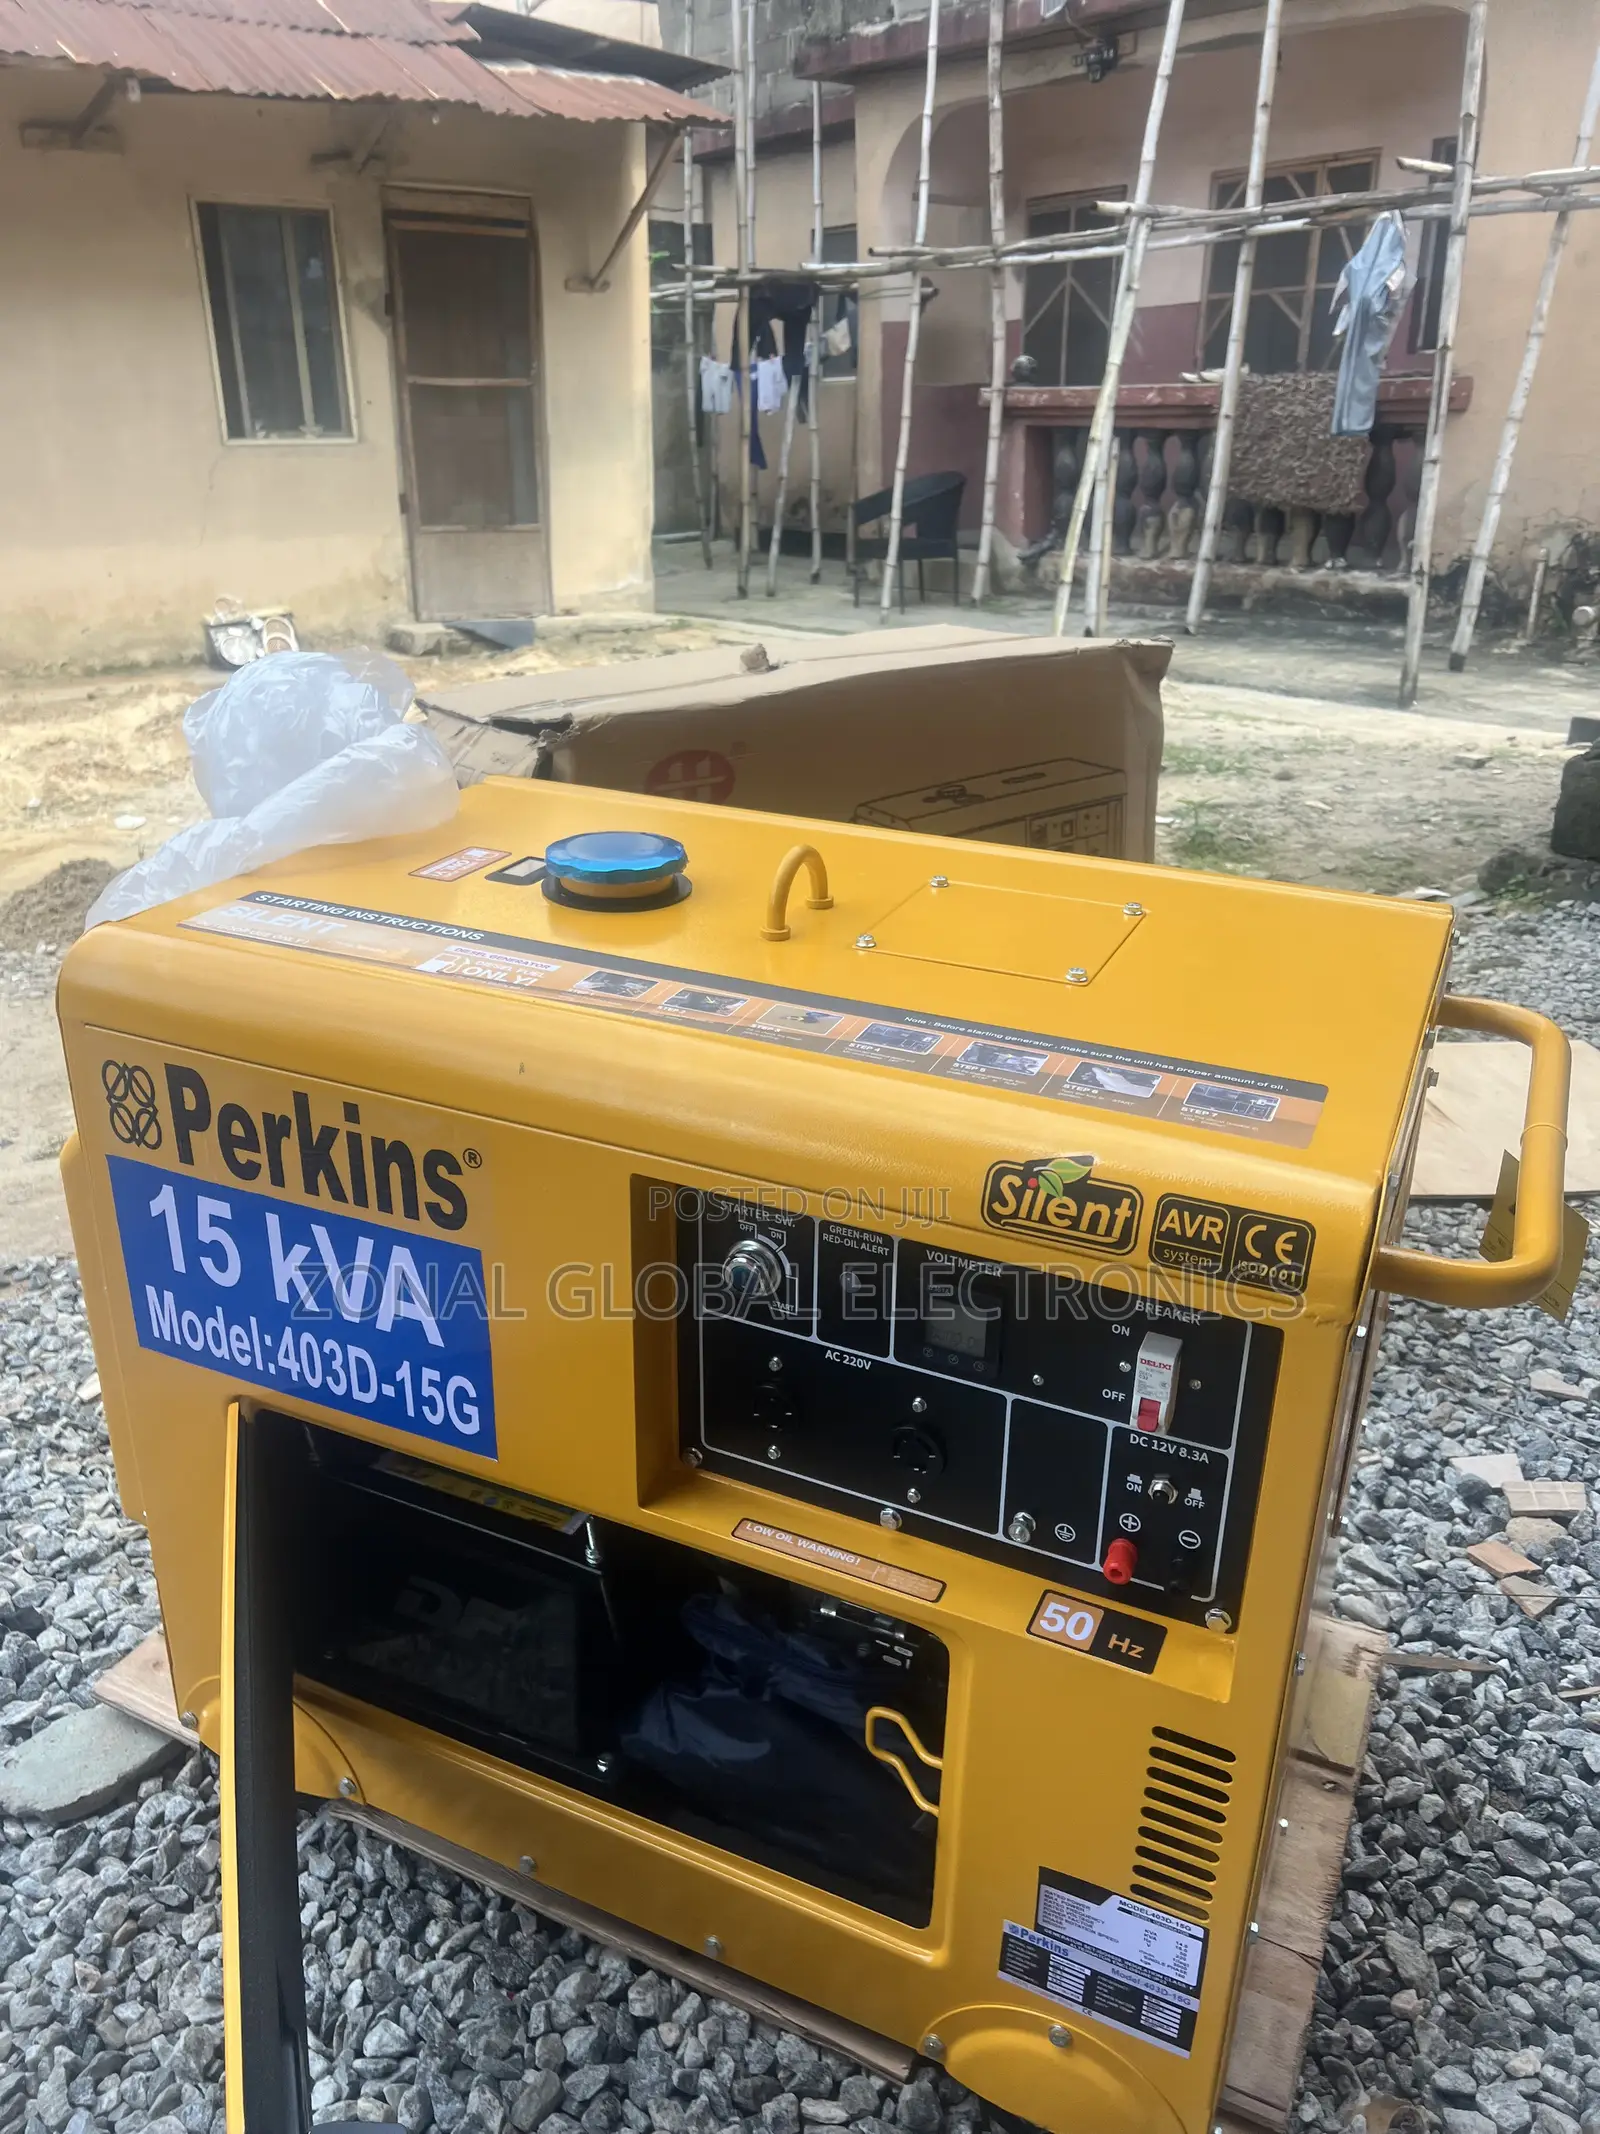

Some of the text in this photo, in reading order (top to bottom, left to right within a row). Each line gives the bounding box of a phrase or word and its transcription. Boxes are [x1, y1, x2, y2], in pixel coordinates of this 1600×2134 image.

[255, 894, 484, 941] STARTING INSTRUCTIONS
[454, 947, 551, 970] DIESEL GENERATOR
[848, 1042, 873, 1050] STEP
[904, 1016, 926, 1026] Note
[933, 1022, 965, 1033] Before
[967, 1027, 1003, 1039] starting
[1004, 1035, 1053, 1048] generator
[1060, 1044, 1087, 1055] make
[1090, 1051, 1113, 1059] sure
[1115, 1053, 1132, 1062] the
[1133, 1057, 1154, 1067] unit
[1155, 1061, 1174, 1070] has
[1176, 1066, 1212, 1078] proper
[1214, 1073, 1255, 1084] amount
[1257, 1078, 1269, 1087] of
[1270, 1082, 1284, 1091] oil
[952, 1062, 979, 1071] STEP
[1062, 1083, 1091, 1092] STEP
[1181, 1106, 1210, 1115] STEP
[720, 1200, 796, 1228] STARTER SW.
[992, 1174, 1133, 1239] Silent
[739, 1223, 754, 1232] OFF
[770, 1230, 782, 1240] ON
[829, 1225, 884, 1245] GREEN-RUN
[1158, 1208, 1225, 1245] AVR
[822, 1233, 890, 1257] RED-OIL ALERT
[148, 1183, 445, 1349] 15 kVA
[926, 1249, 1002, 1278] VOLTMETER
[1163, 1248, 1213, 1268] system
[772, 1301, 795, 1312] START
[1135, 1299, 1201, 1326] BREAKER
[1111, 1324, 1131, 1337] ON
[825, 1349, 872, 1371] AC 220V
[1140, 1357, 1172, 1371] DELIXI
[1102, 1388, 1126, 1402] OFF
[1129, 1433, 1209, 1464] DC 12V 8.3A
[1126, 1482, 1142, 1494] ON
[1184, 1497, 1205, 1510] OFF
[745, 1522, 861, 1566] LOW OIL WARNING!
[1039, 1601, 1145, 1660] 50 Hz
[1019, 1927, 1069, 1957] Perkins
